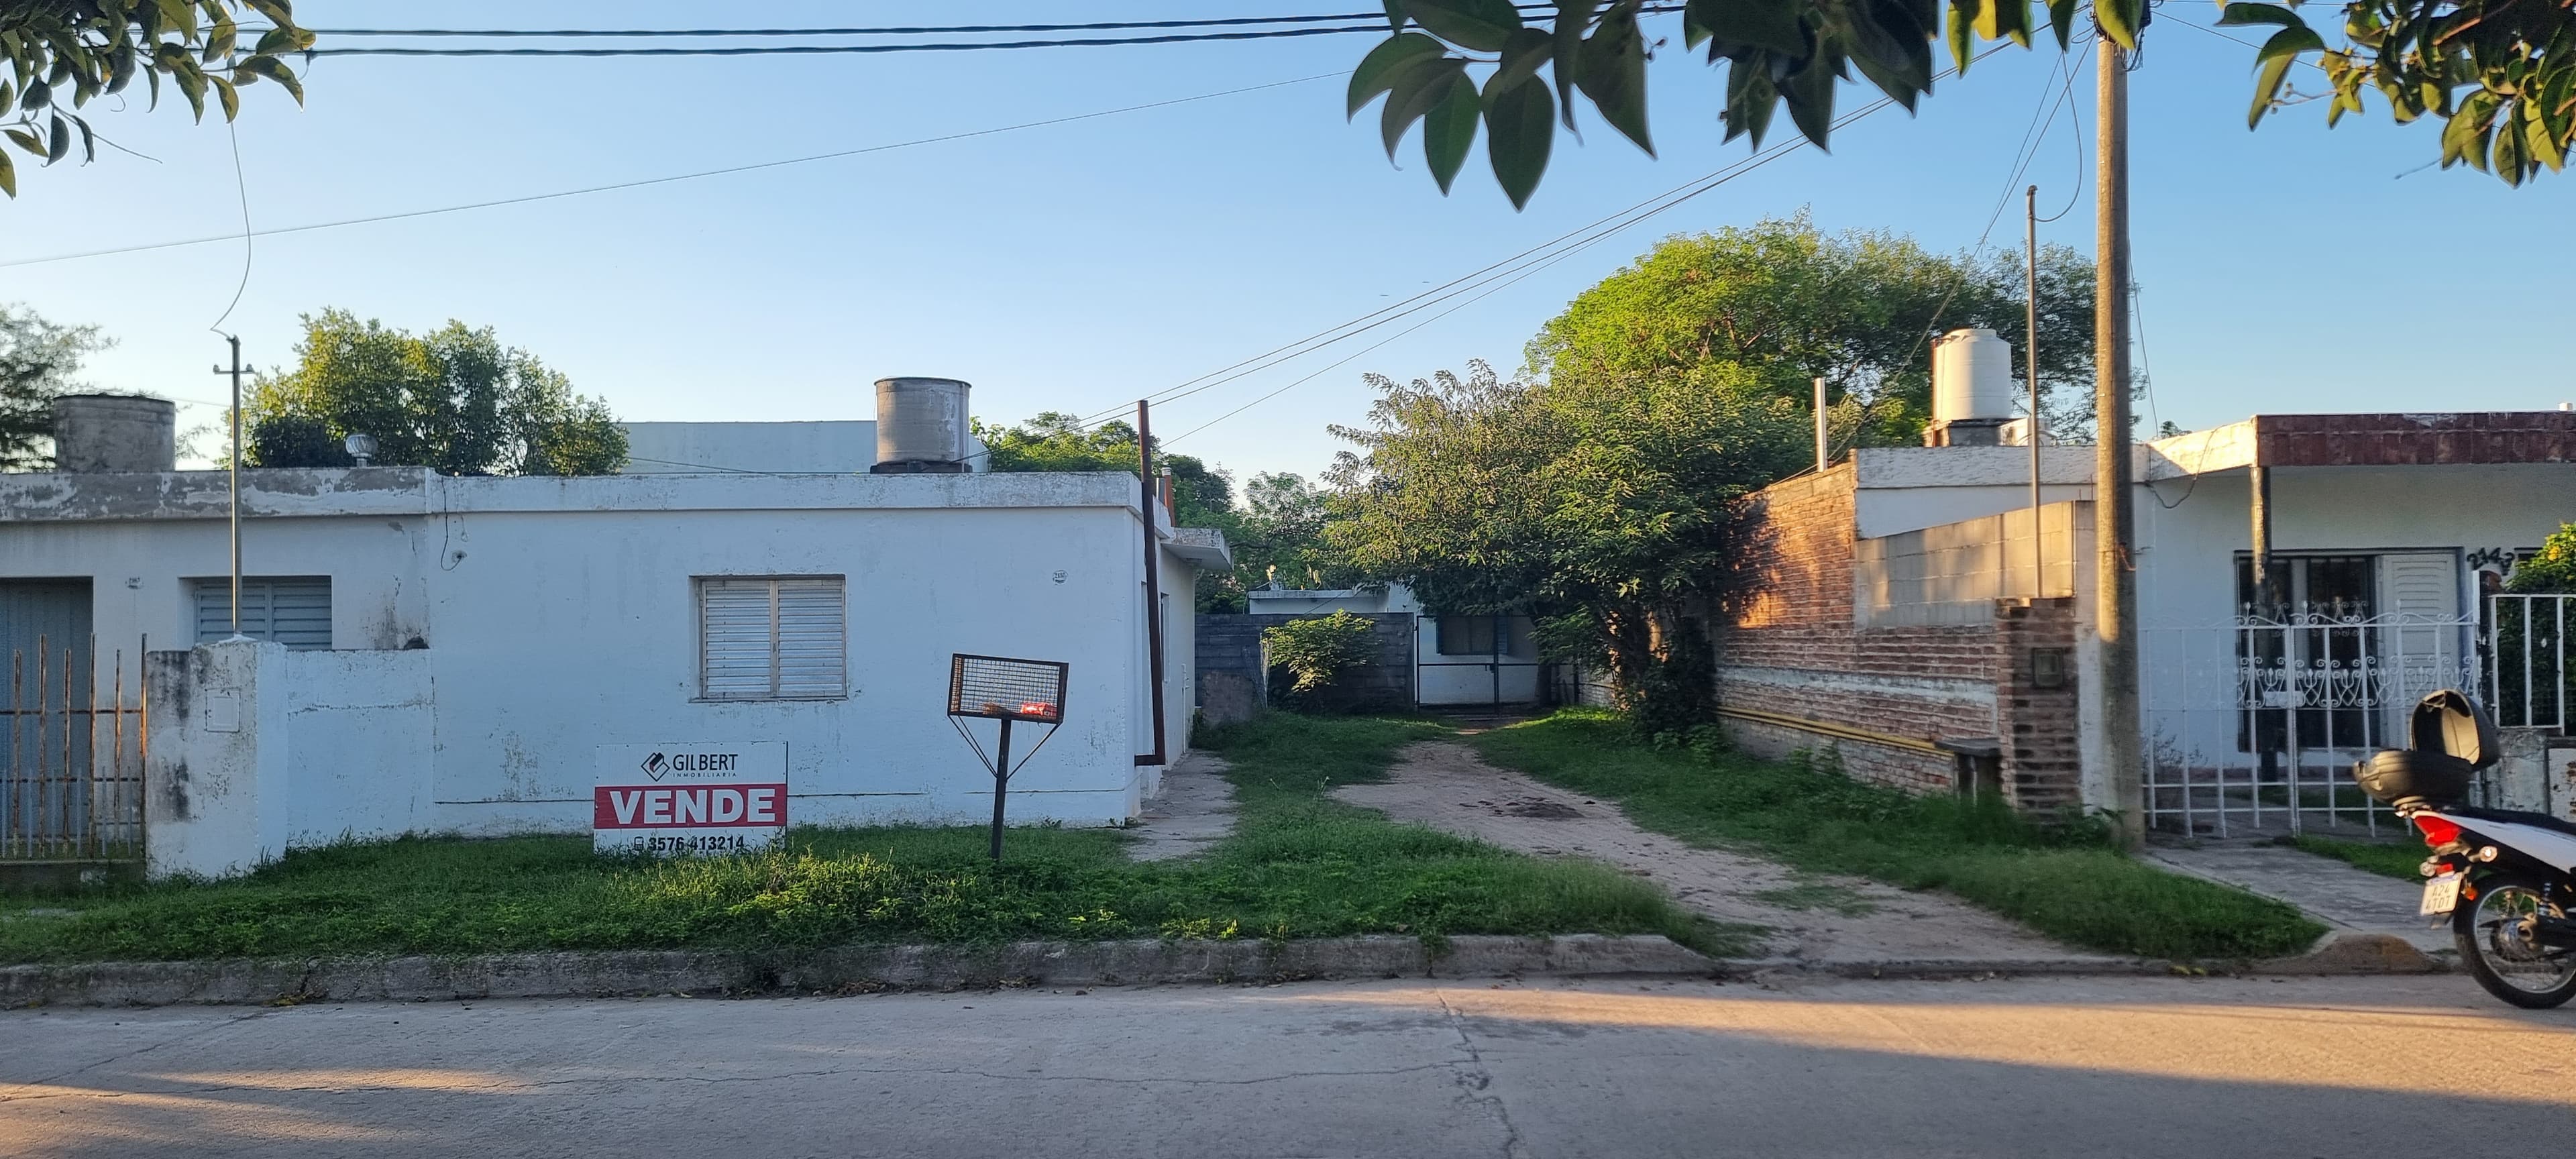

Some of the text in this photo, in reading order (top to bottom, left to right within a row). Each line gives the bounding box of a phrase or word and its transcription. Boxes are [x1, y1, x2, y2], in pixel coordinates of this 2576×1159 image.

[673, 754, 739, 771] GILBERT
[609, 788, 775, 824] VENDE
[649, 836, 744, 850] 3576 413214
